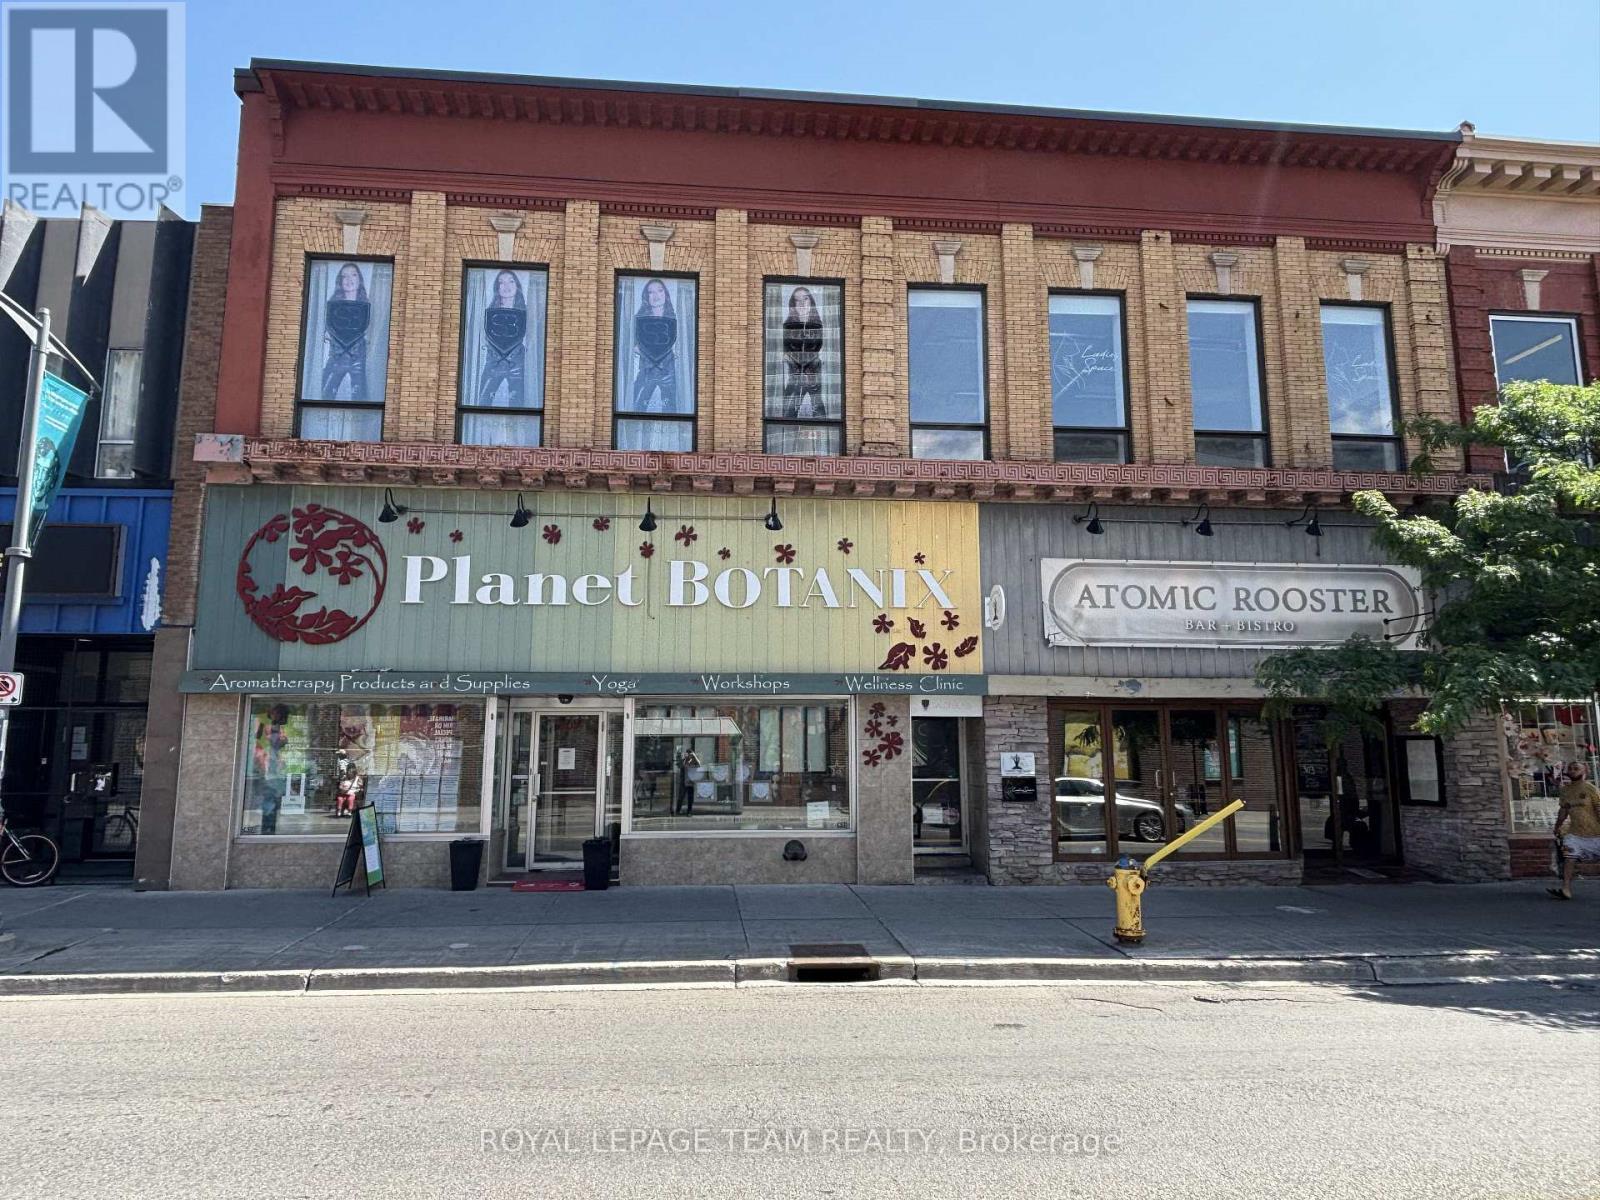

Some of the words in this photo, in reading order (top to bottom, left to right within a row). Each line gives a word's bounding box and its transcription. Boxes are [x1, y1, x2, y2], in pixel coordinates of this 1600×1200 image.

[400, 554, 645, 607] Planet
[664, 560, 956, 609] BOTANIX
[1074, 583, 1217, 610] ATOMIC
[1232, 586, 1394, 613] ROOSTER
[1185, 619, 1217, 632] BAR
[1237, 619, 1294, 632] BISTRO
[208, 672, 335, 694] Aromatherapy
[340, 674, 416, 692] Products
[453, 674, 531, 694] Supplies
[592, 674, 637, 694] Yoga
[701, 674, 791, 694] Workshops
[845, 675, 913, 691] Wellness
[919, 676, 965, 692] Clinic
